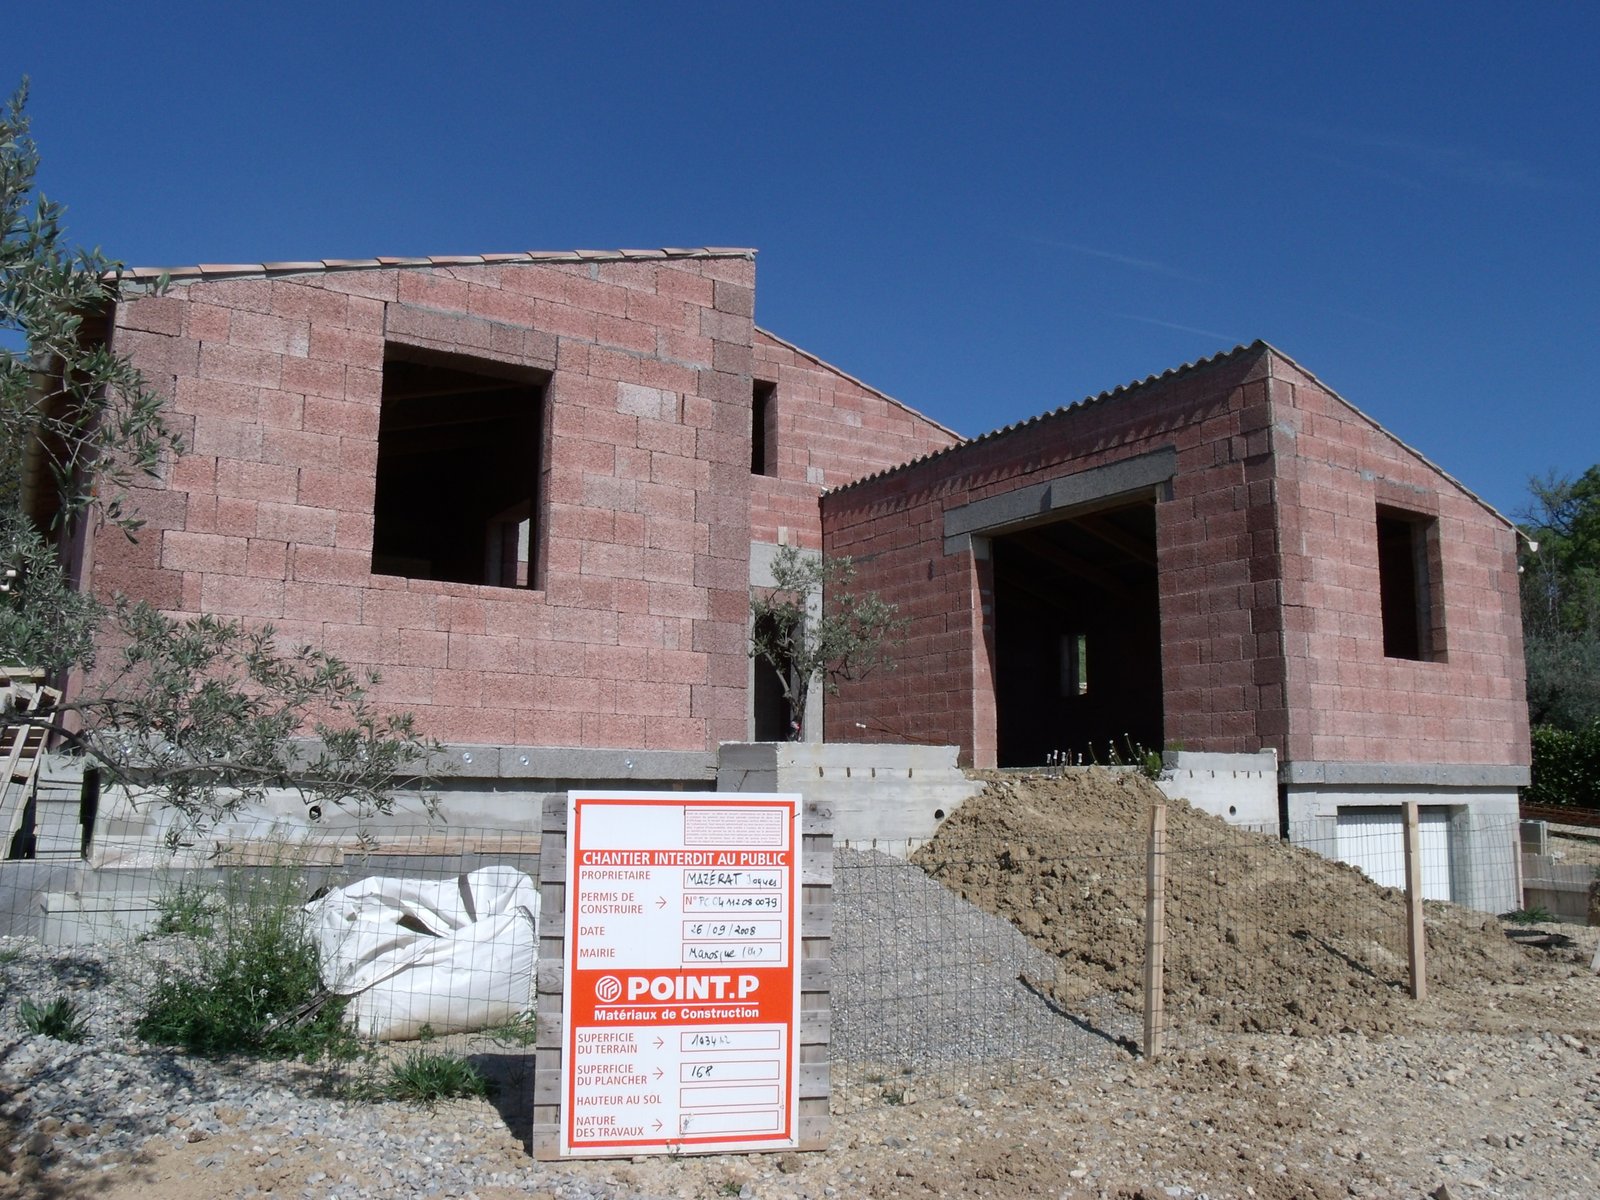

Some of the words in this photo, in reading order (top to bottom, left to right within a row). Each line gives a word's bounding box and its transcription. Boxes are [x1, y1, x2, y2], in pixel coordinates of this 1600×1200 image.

[583, 852, 650, 865] CHANTIER
[655, 852, 714, 864] INTERDIT
[718, 853, 735, 864] AU
[740, 853, 785, 865] PUBLIC
[582, 870, 650, 880] PROPRIETAIRE
[581, 893, 618, 901] PERMIS
[622, 893, 634, 901] DE
[686, 896, 697, 905] N°
[581, 904, 643, 914] CONSTRUIRE
[580, 927, 605, 935] DATE
[580, 949, 615, 958] MAIRIE
[628, 975, 759, 1000] POINT.P
[594, 1010, 656, 1020] Matériaux
[662, 1009, 676, 1019] de
[681, 1008, 759, 1018] Construction
[578, 1033, 634, 1043] SUPERFICIE
[578, 1045, 592, 1054] DU
[596, 1044, 637, 1053] TERRAIN
[578, 1064, 633, 1074] SUPERFICIE
[692, 1065, 713, 1078] 168
[577, 1076, 592, 1085] DU
[596, 1076, 647, 1084] PLANCHER
[577, 1096, 623, 1105] HAUTEUR
[626, 1096, 640, 1104] AU
[644, 1095, 661, 1104] SOL
[577, 1116, 616, 1125] NATURE
[576, 1128, 594, 1138] DES
[598, 1127, 644, 1136] TRAVAUX
